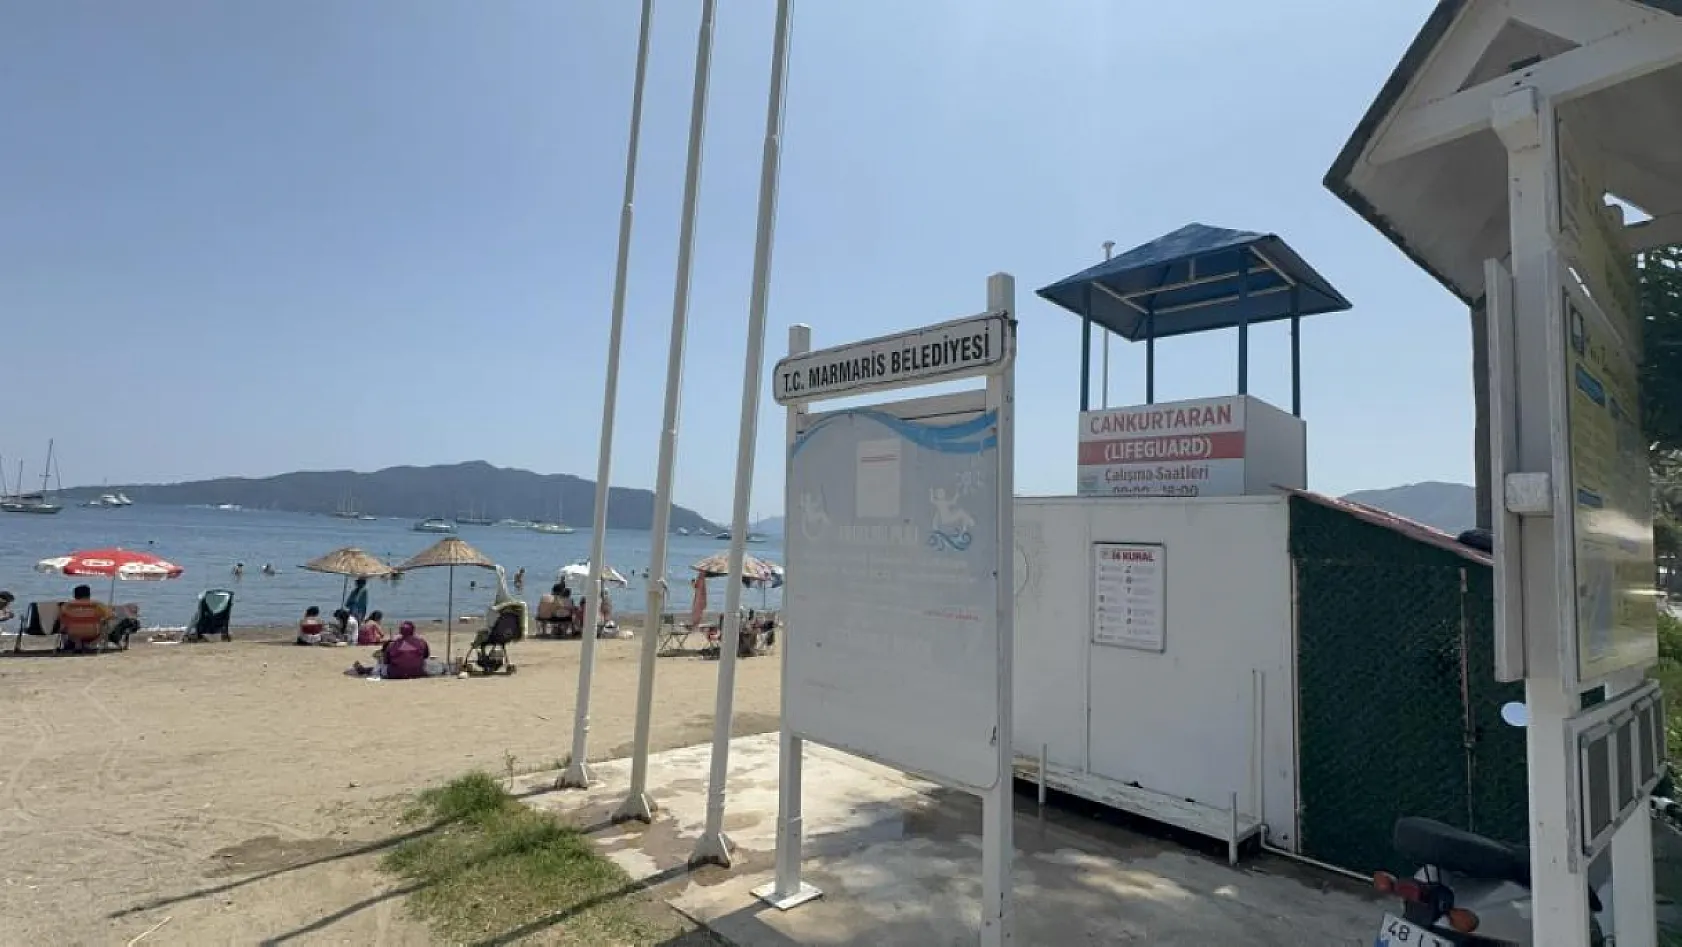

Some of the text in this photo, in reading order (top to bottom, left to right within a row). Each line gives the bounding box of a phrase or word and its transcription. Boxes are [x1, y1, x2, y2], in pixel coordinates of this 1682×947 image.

[783, 327, 990, 392] T.C. MARMARİS BELEDİYESİ
[1090, 403, 1232, 434] CANKURTARAN
[1103, 436, 1212, 461] (LIFEGUARD)
[1105, 464, 1209, 484] Çalışma Saatleri
